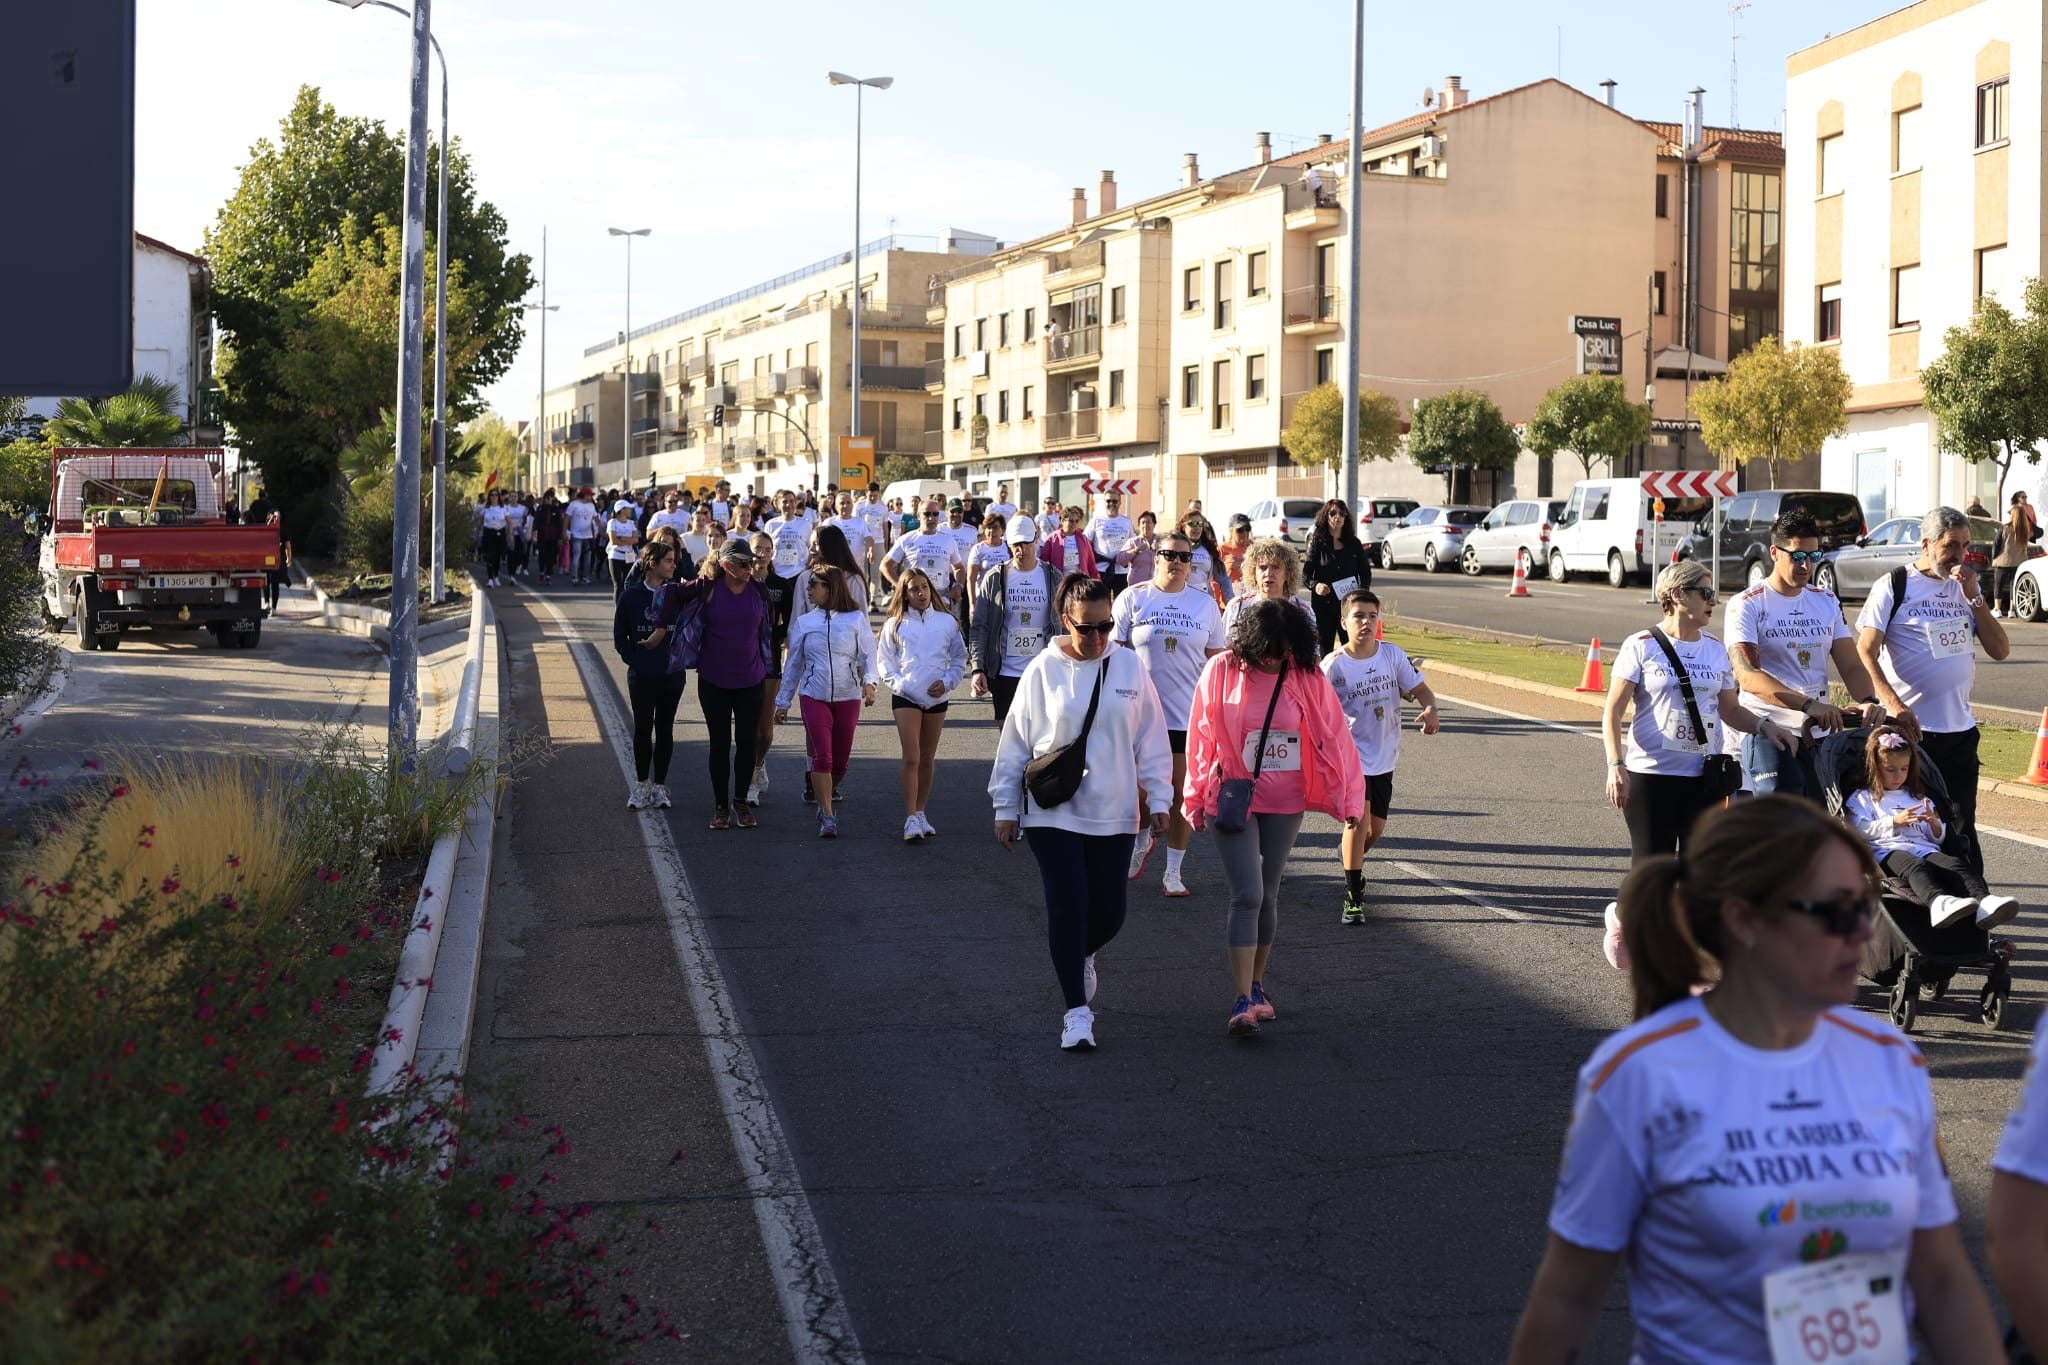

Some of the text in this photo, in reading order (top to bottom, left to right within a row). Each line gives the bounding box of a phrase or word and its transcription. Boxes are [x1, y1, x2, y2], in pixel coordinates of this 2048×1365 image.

[1577, 318, 1620, 332] Casa Lucy
[1584, 337, 1618, 358] GRILL
[166, 578, 186, 587] 1305
[1340, 583, 1355, 594] 684
[1922, 600, 1964, 609] III CARRERA
[1161, 611, 1192, 620] CARRERA
[96, 623, 119, 632] JPM
[232, 622, 255, 631] JPM
[1180, 620, 1203, 630] CIVIL
[1778, 618, 1822, 627] III CARRERA
[1765, 628, 1808, 638] GVARDIA
[1939, 630, 1967, 647] 823
[1014, 637, 1037, 648] 287
[1364, 674, 1391, 686] CARRERA
[1676, 725, 1698, 741] 85
[1726, 1129, 1757, 1152] III
[1799, 1299, 1882, 1363] 685
